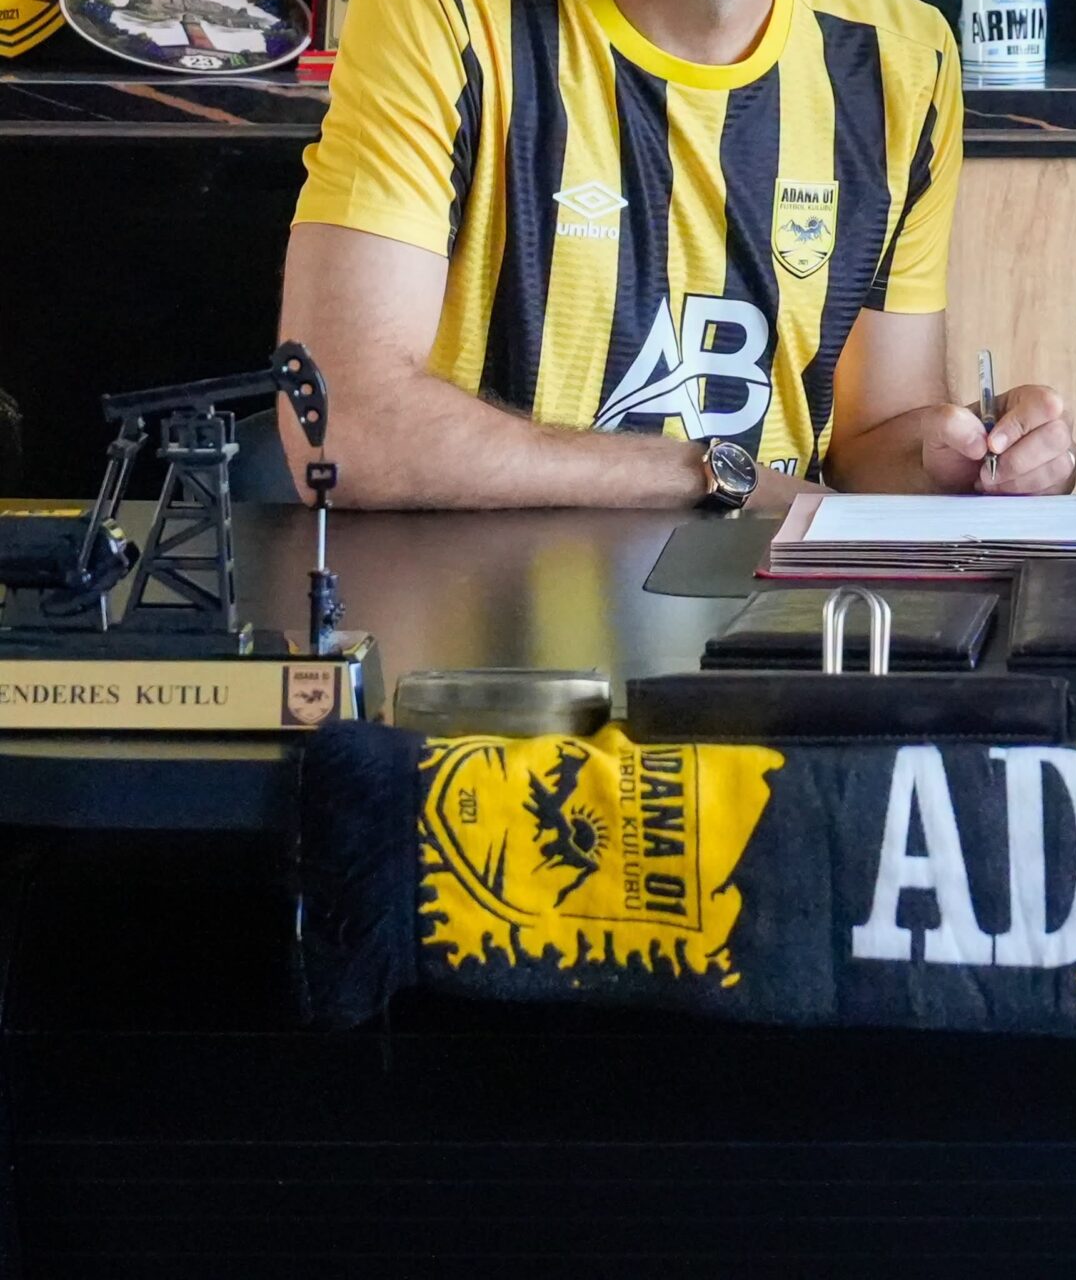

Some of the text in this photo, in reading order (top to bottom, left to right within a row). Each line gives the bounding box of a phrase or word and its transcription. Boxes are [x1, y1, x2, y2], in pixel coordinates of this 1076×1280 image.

[189, 56, 213, 67] 23
[781, 187, 834, 204] ADANA 01
[556, 221, 619, 240] umbro
[594, 293, 772, 440] AB
[136, 685, 229, 706] KUTLU
[459, 786, 478, 824] 2021
[644, 872, 687, 917] 01
